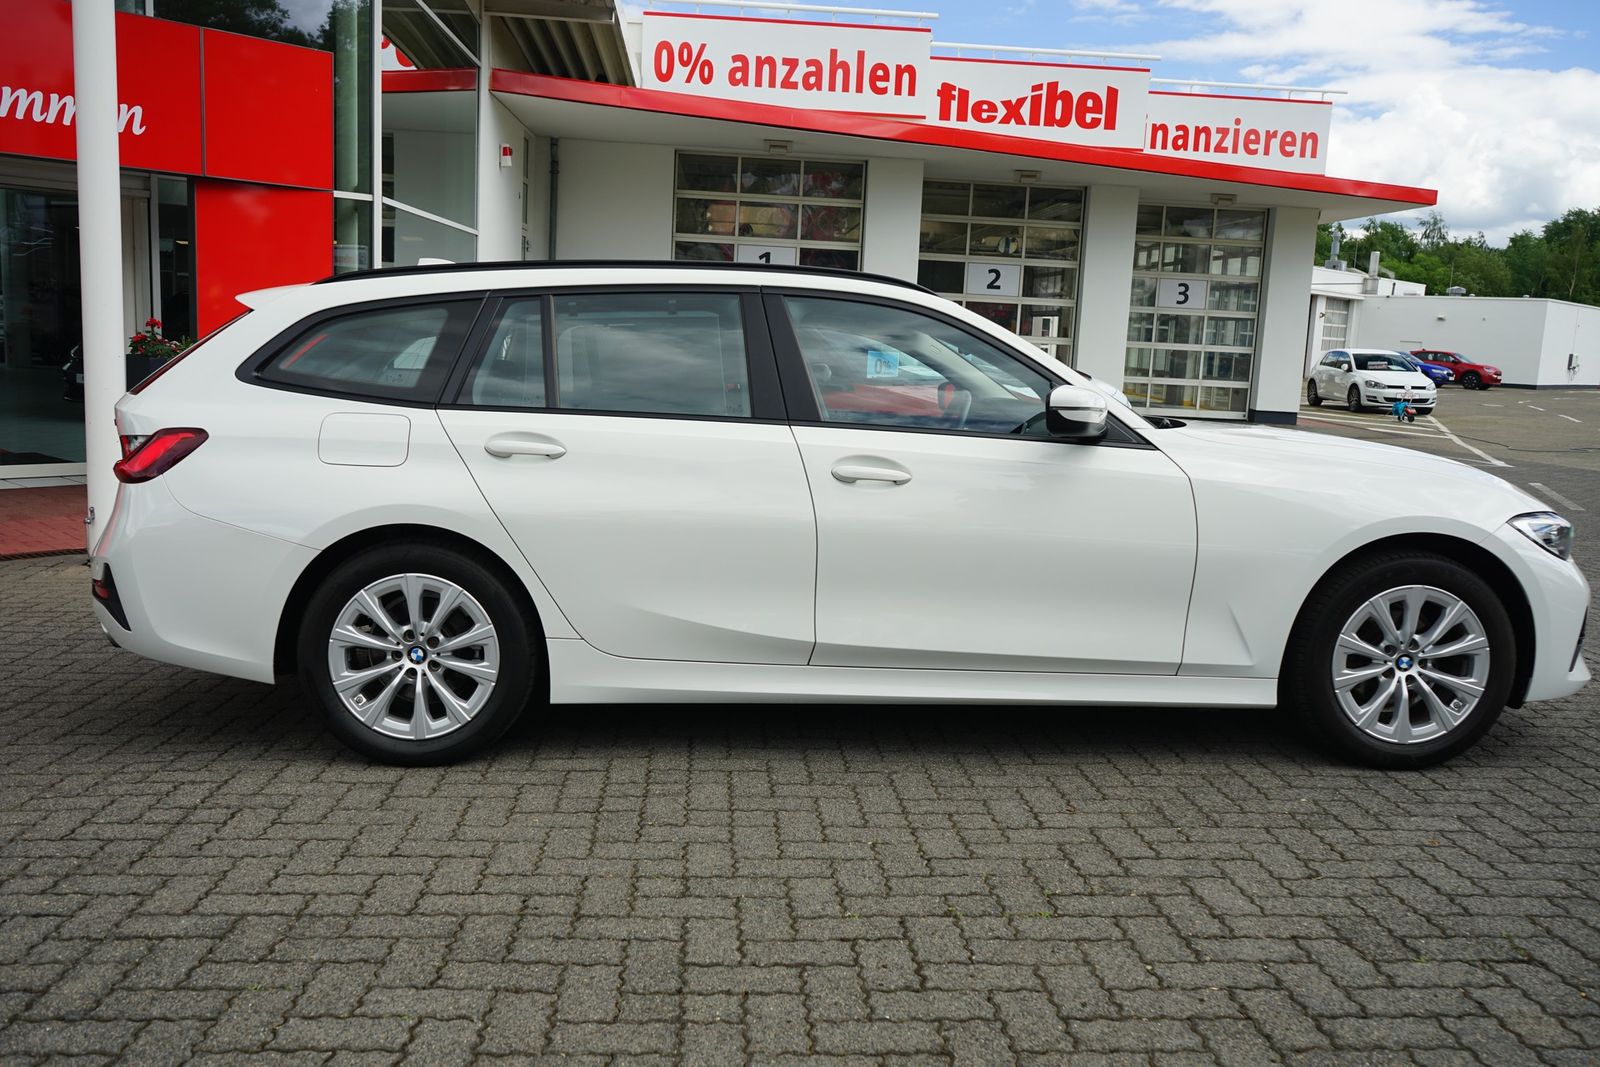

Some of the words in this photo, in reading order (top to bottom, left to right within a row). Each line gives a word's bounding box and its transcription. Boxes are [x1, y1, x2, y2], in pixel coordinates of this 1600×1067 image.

[653, 40, 714, 85] 0%
[727, 48, 917, 97] anzahlen
[0, 85, 147, 136] mmn
[937, 80, 1119, 131] flexibel
[1144, 114, 1319, 159] nanzieren
[758, 251, 771, 264] 1
[986, 268, 1001, 290] 2
[1176, 282, 1190, 305] 3
